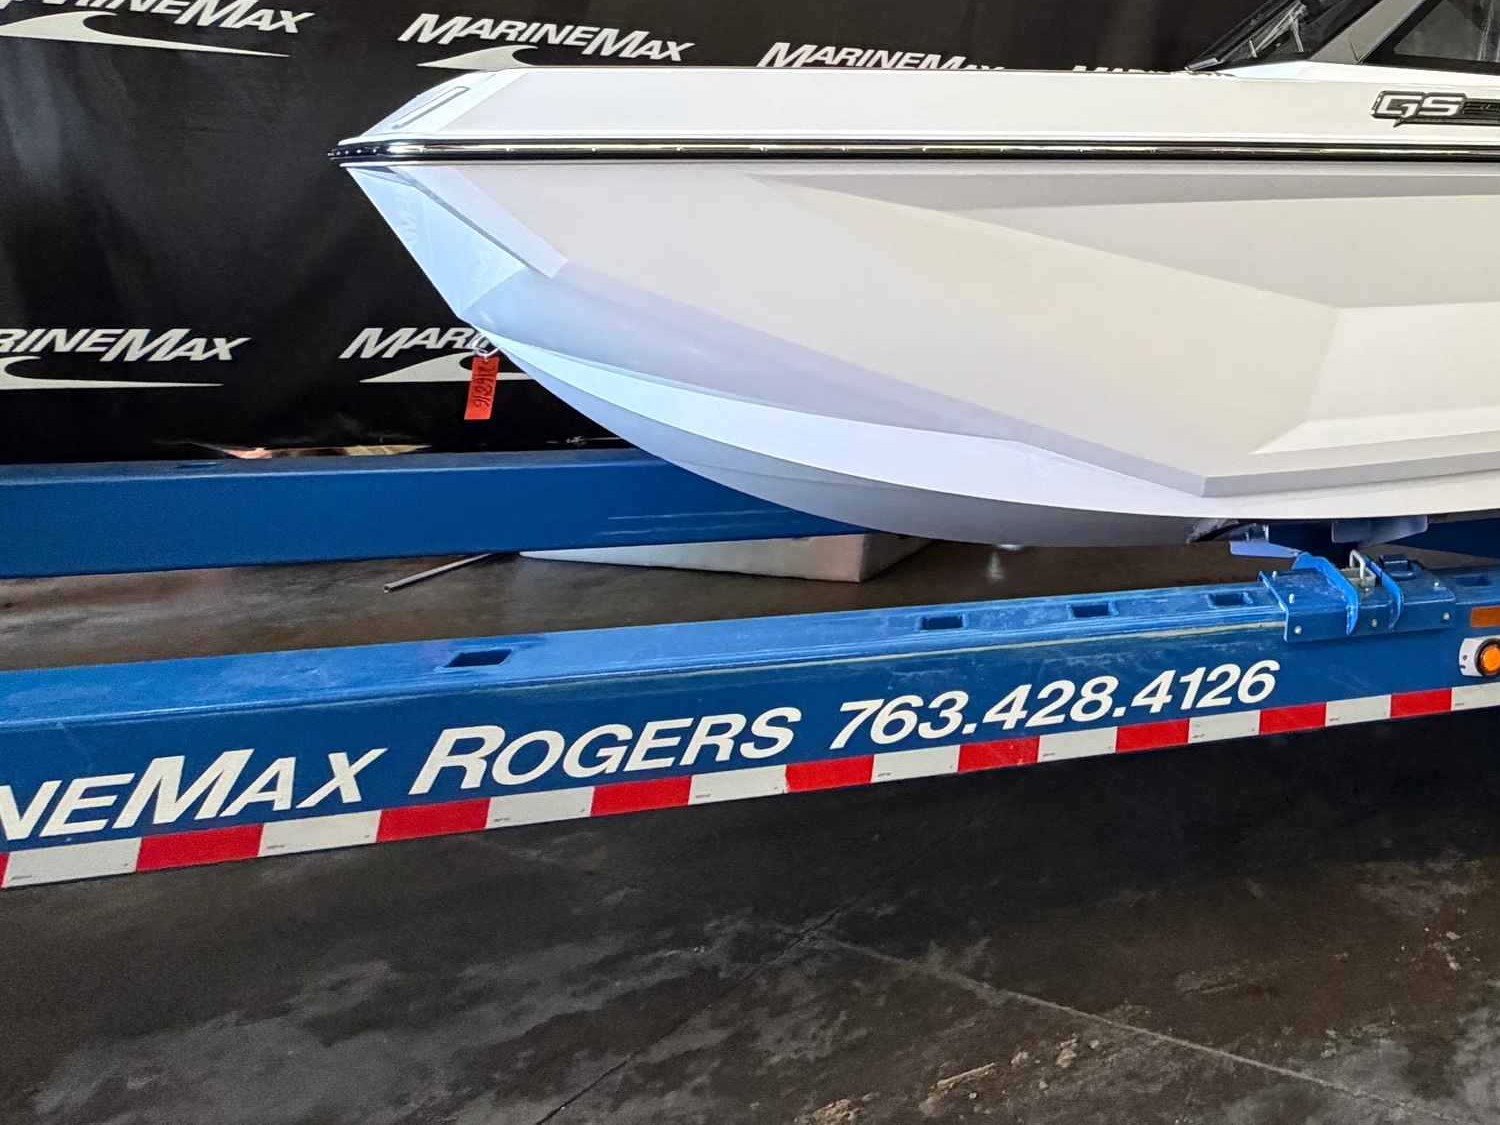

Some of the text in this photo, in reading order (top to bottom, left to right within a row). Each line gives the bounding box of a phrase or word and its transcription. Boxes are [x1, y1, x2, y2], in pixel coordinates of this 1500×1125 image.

[756, 41, 1005, 70] MARINEM
[408, 706, 804, 796] ROGERS
[828, 658, 1281, 751] 763.428.4126
